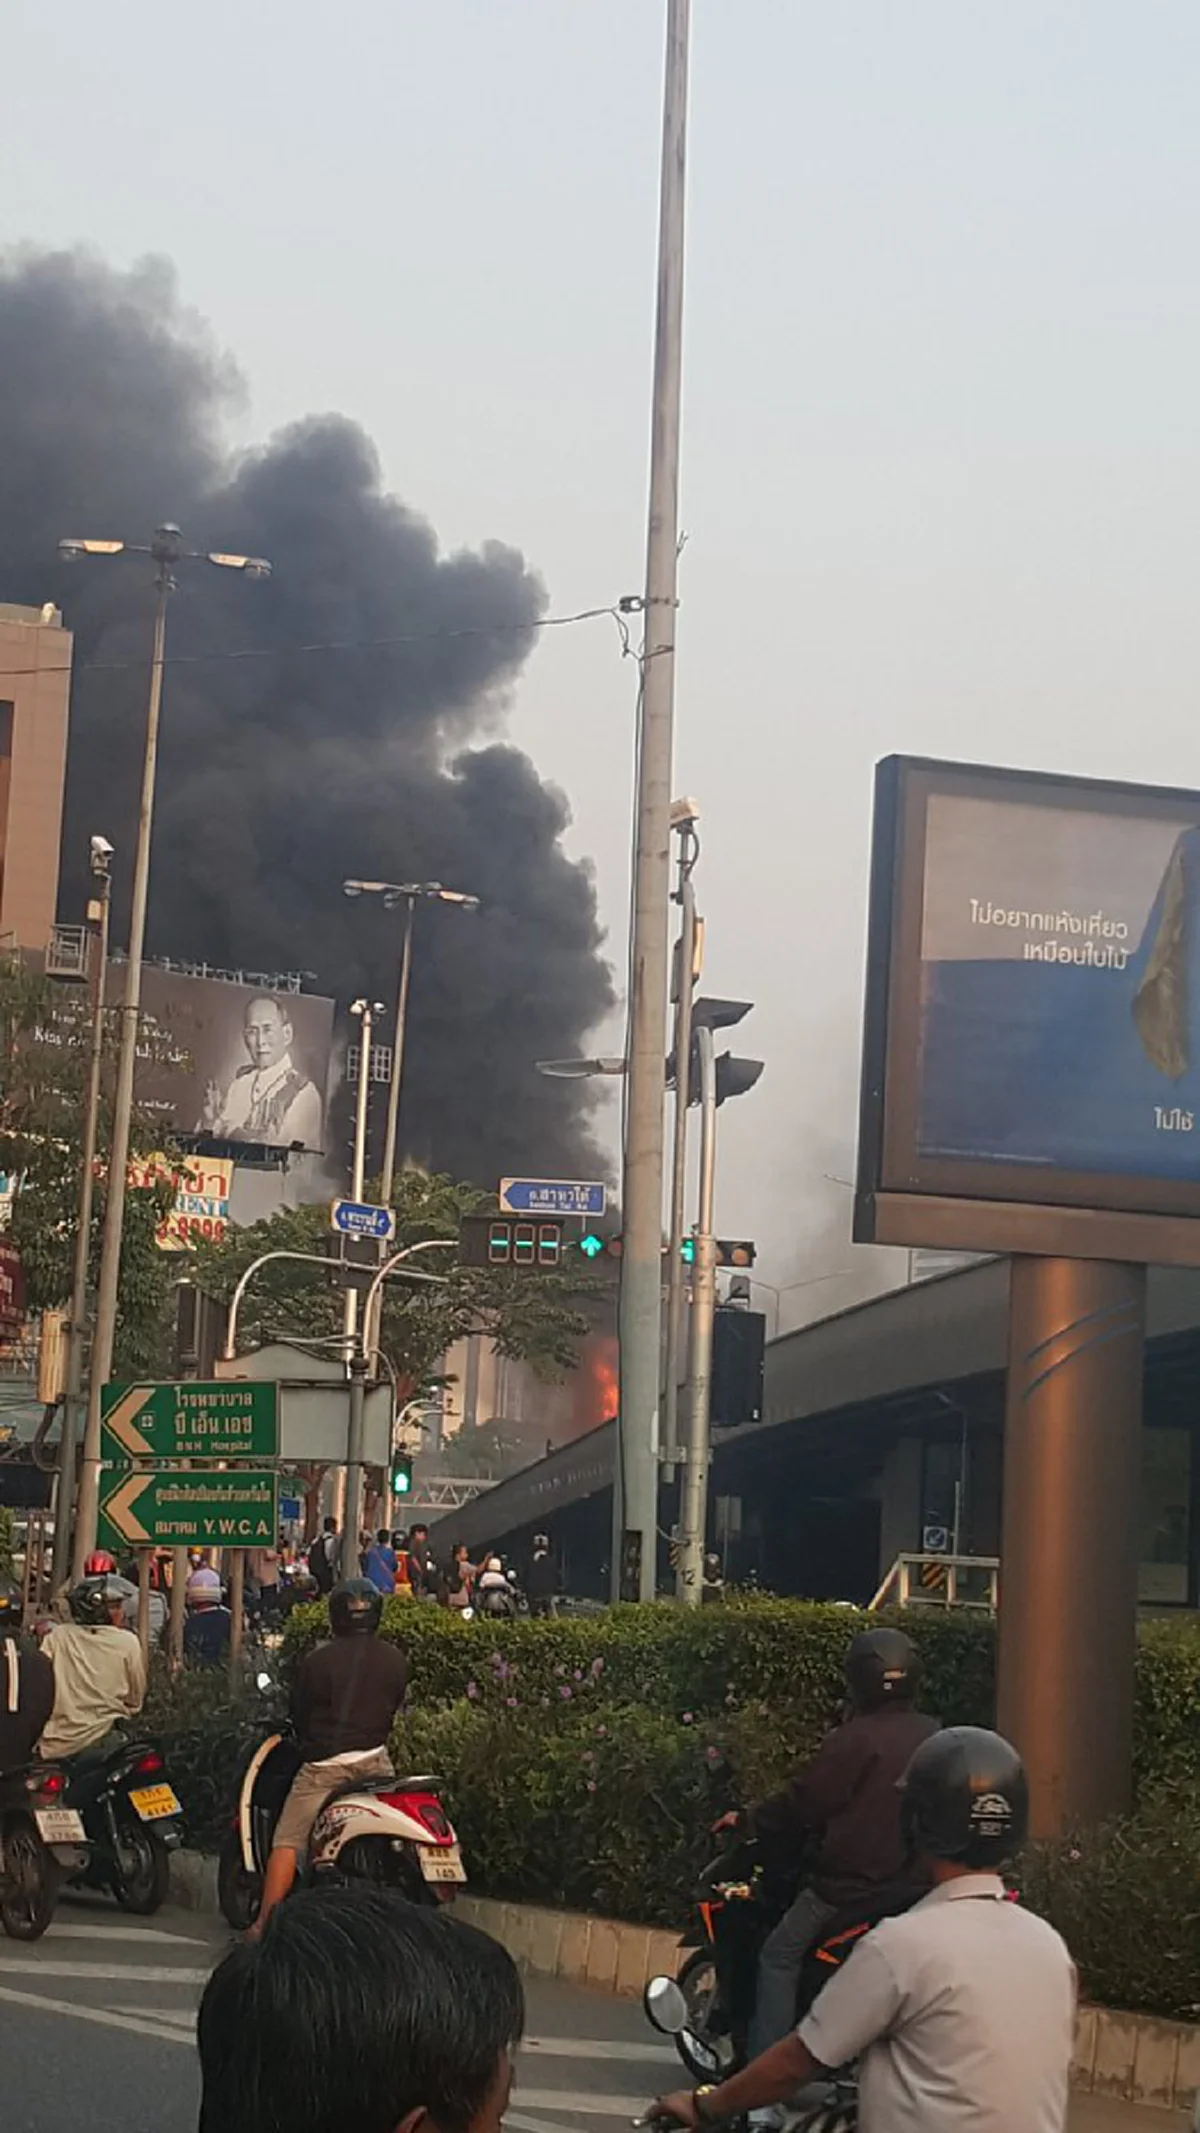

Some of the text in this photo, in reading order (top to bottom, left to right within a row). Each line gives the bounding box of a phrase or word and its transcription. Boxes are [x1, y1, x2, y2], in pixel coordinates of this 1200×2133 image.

[970, 898, 1128, 939] ไม่อยากแห้งเหี่ยว
[1024, 940, 1131, 970] เหมือนใบไม้
[174, 1385, 252, 1408] โรงพยาบาล
[176, 1441, 252, 1453] BNH Hospital
